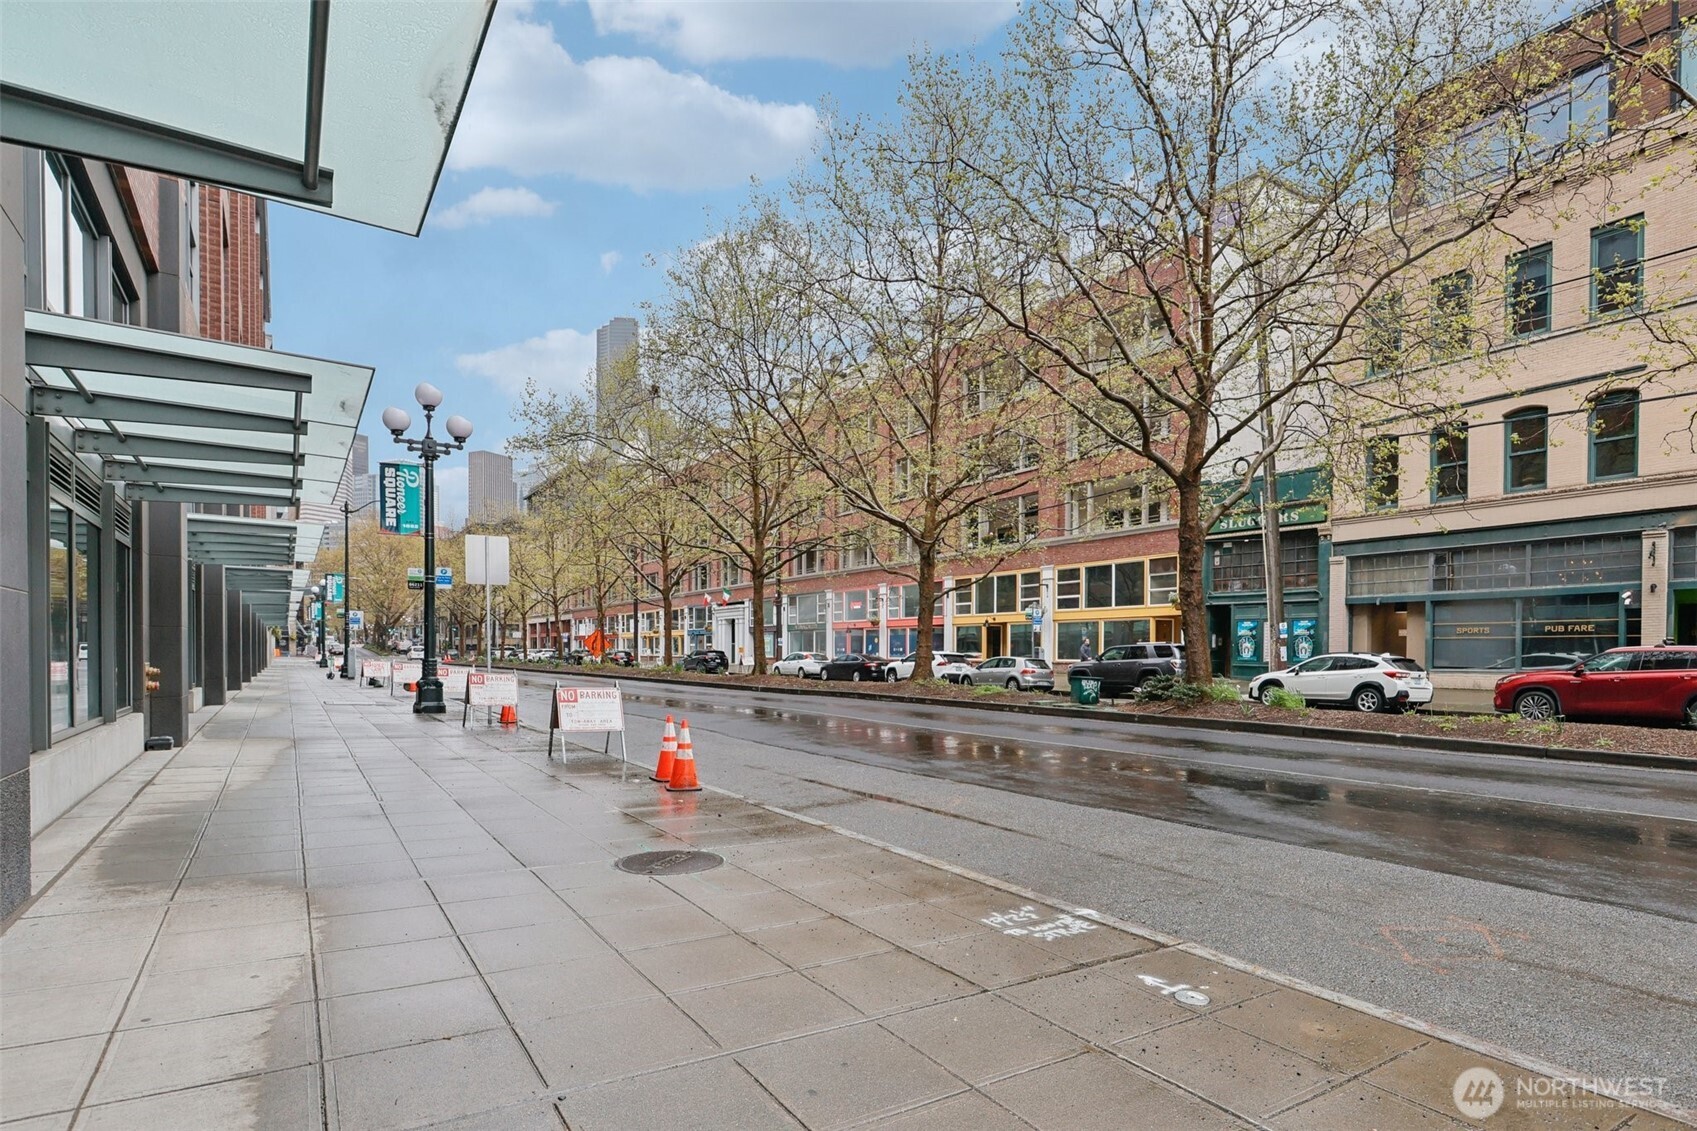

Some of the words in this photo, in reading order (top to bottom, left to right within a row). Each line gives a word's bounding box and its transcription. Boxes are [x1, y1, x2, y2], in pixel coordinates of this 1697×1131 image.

[396, 468, 420, 515] Pioneer
[383, 467, 397, 527] SQUARE
[1220, 511, 1300, 529] SLUGGRS
[1456, 626, 1490, 634] SPORTS
[1544, 625, 1565, 633] PUB
[1568, 624, 1595, 632] FARE
[437, 668, 448, 676] NO
[471, 675, 484, 684] NO
[560, 691, 575, 701] NO
